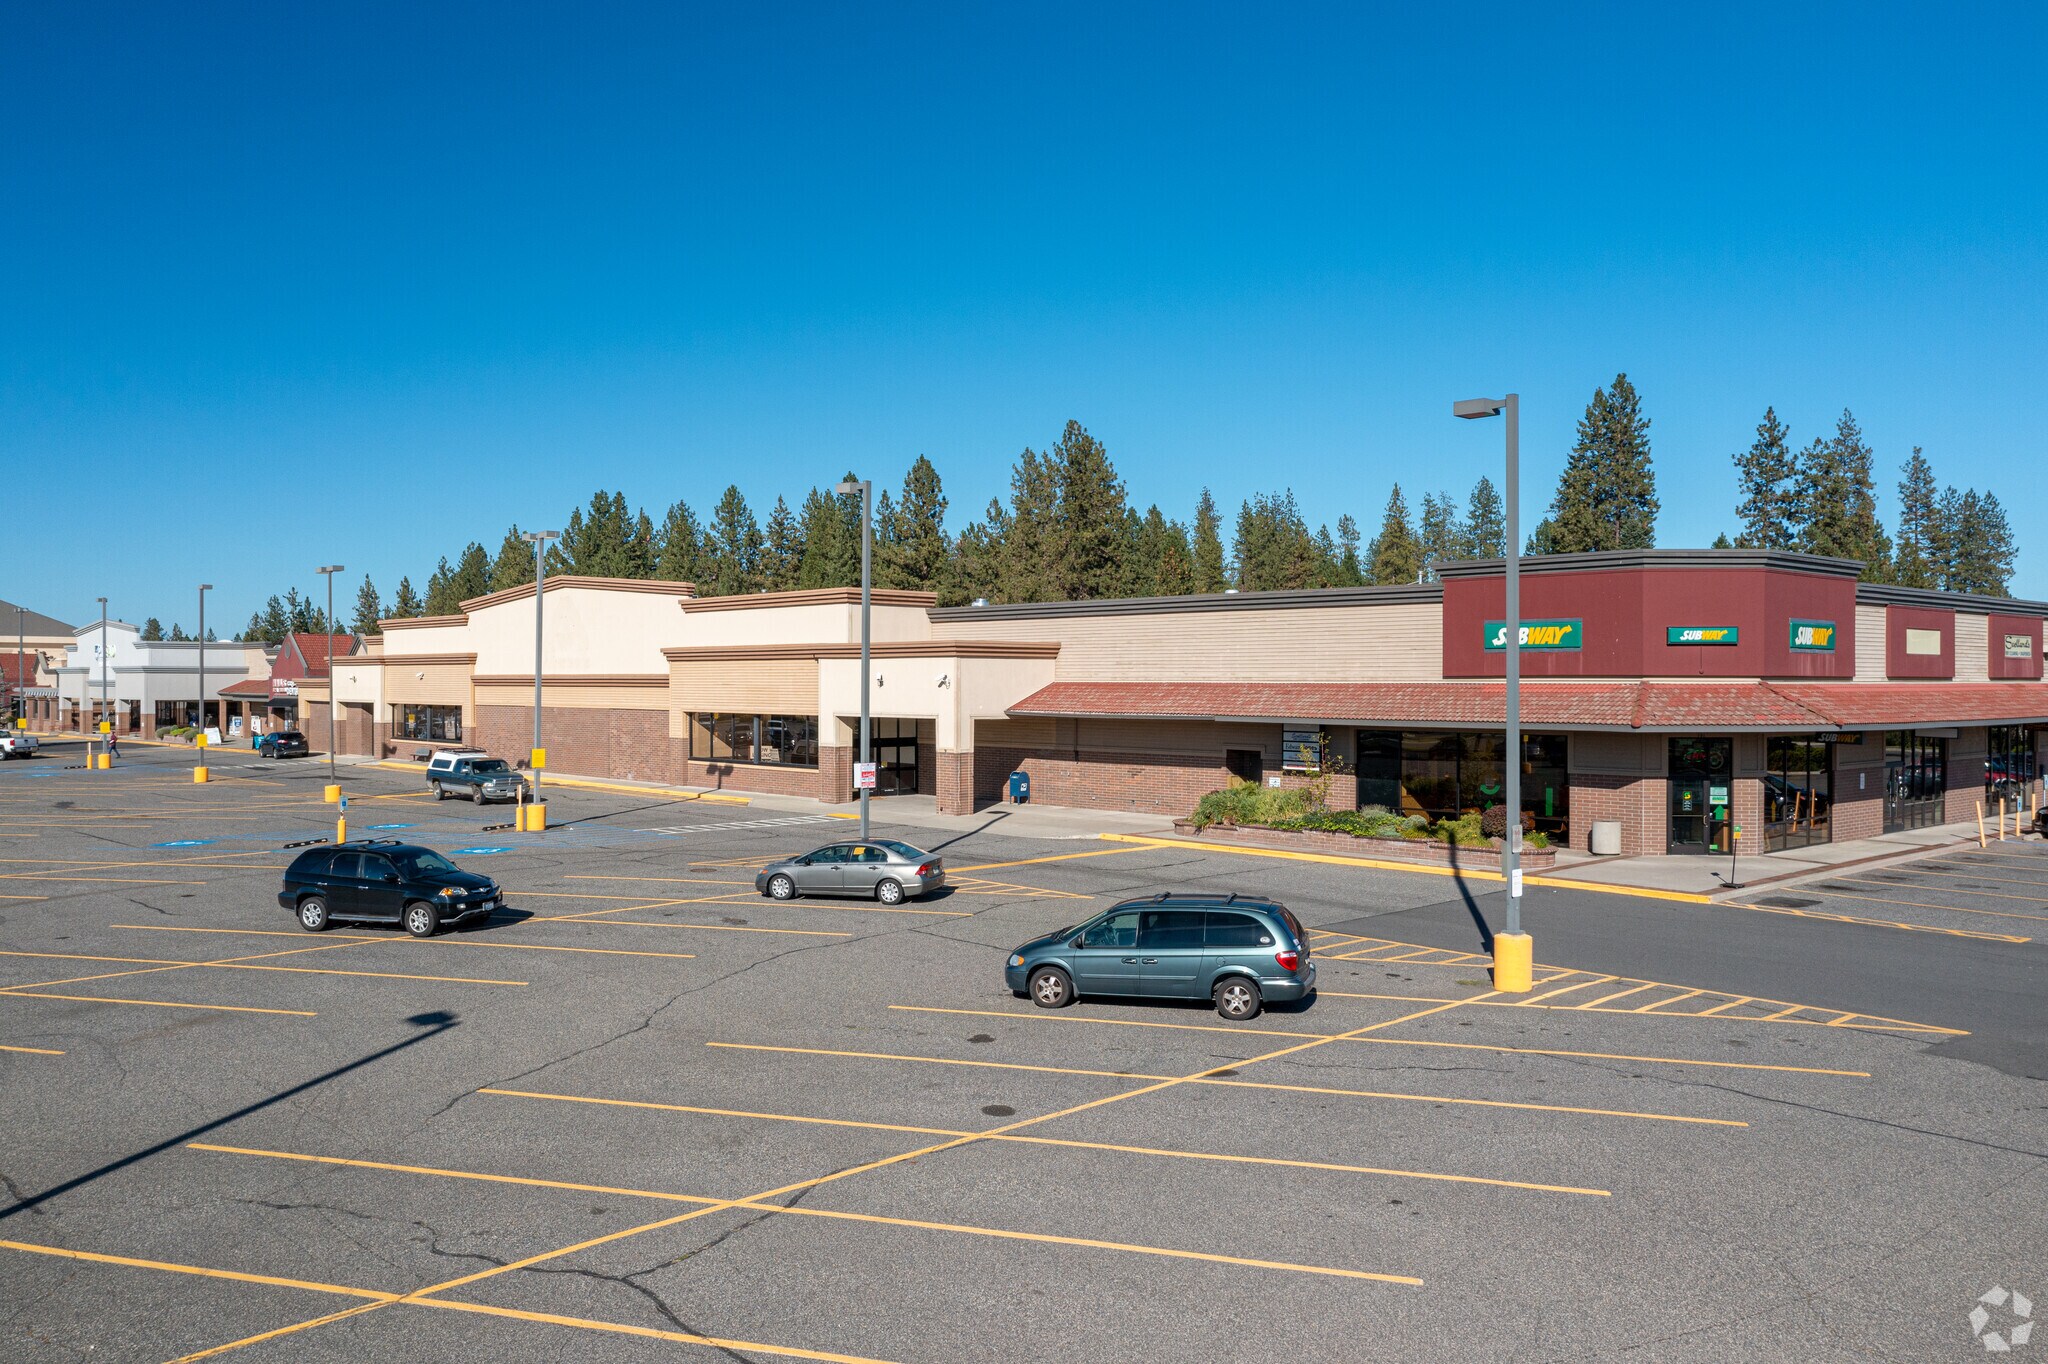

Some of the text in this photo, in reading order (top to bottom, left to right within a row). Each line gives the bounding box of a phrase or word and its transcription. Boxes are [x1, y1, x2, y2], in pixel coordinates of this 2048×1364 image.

[1492, 625, 1572, 646] SBWAY
[1680, 629, 1728, 641] SUBWAY
[1795, 626, 1833, 646] SUBWAY
[1818, 733, 1860, 743] SUBWAY
